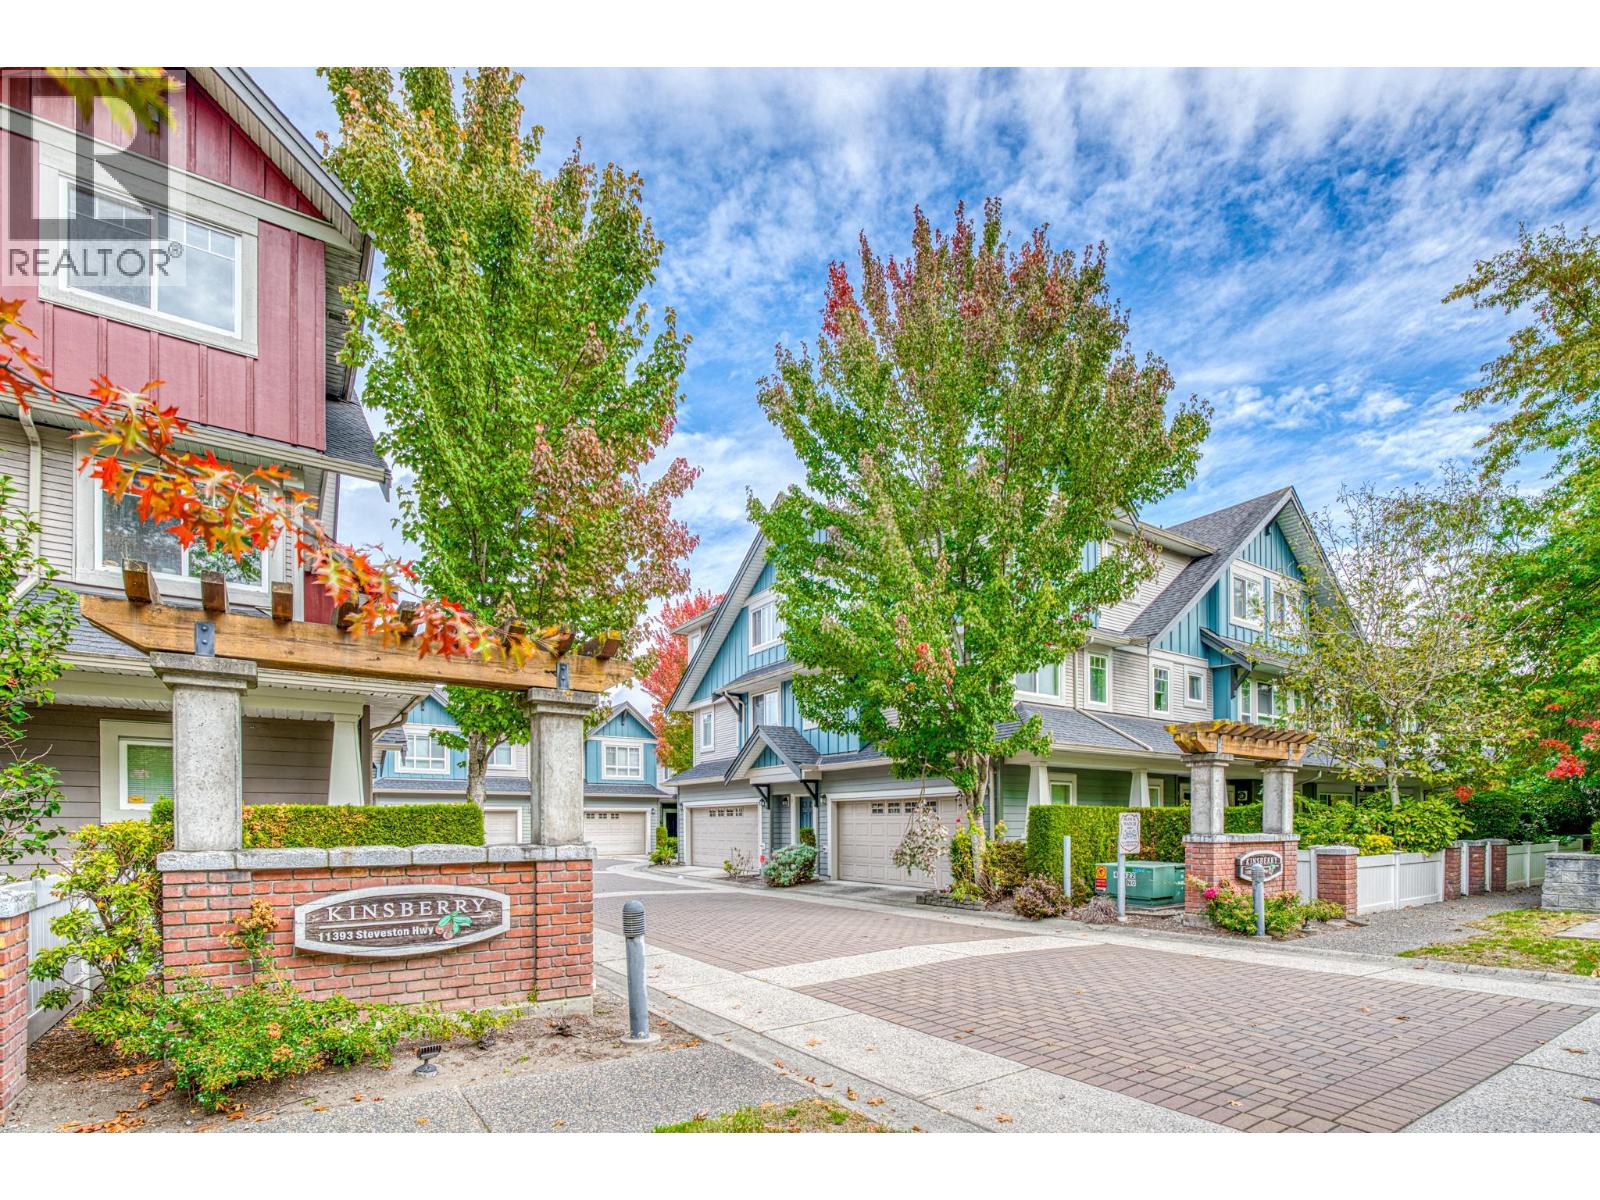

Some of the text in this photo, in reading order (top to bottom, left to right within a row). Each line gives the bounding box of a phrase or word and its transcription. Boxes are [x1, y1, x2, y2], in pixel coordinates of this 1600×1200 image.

[326, 898, 487, 922] KINSBERRY
[318, 926, 434, 942] 11393 Steveston Hwy
